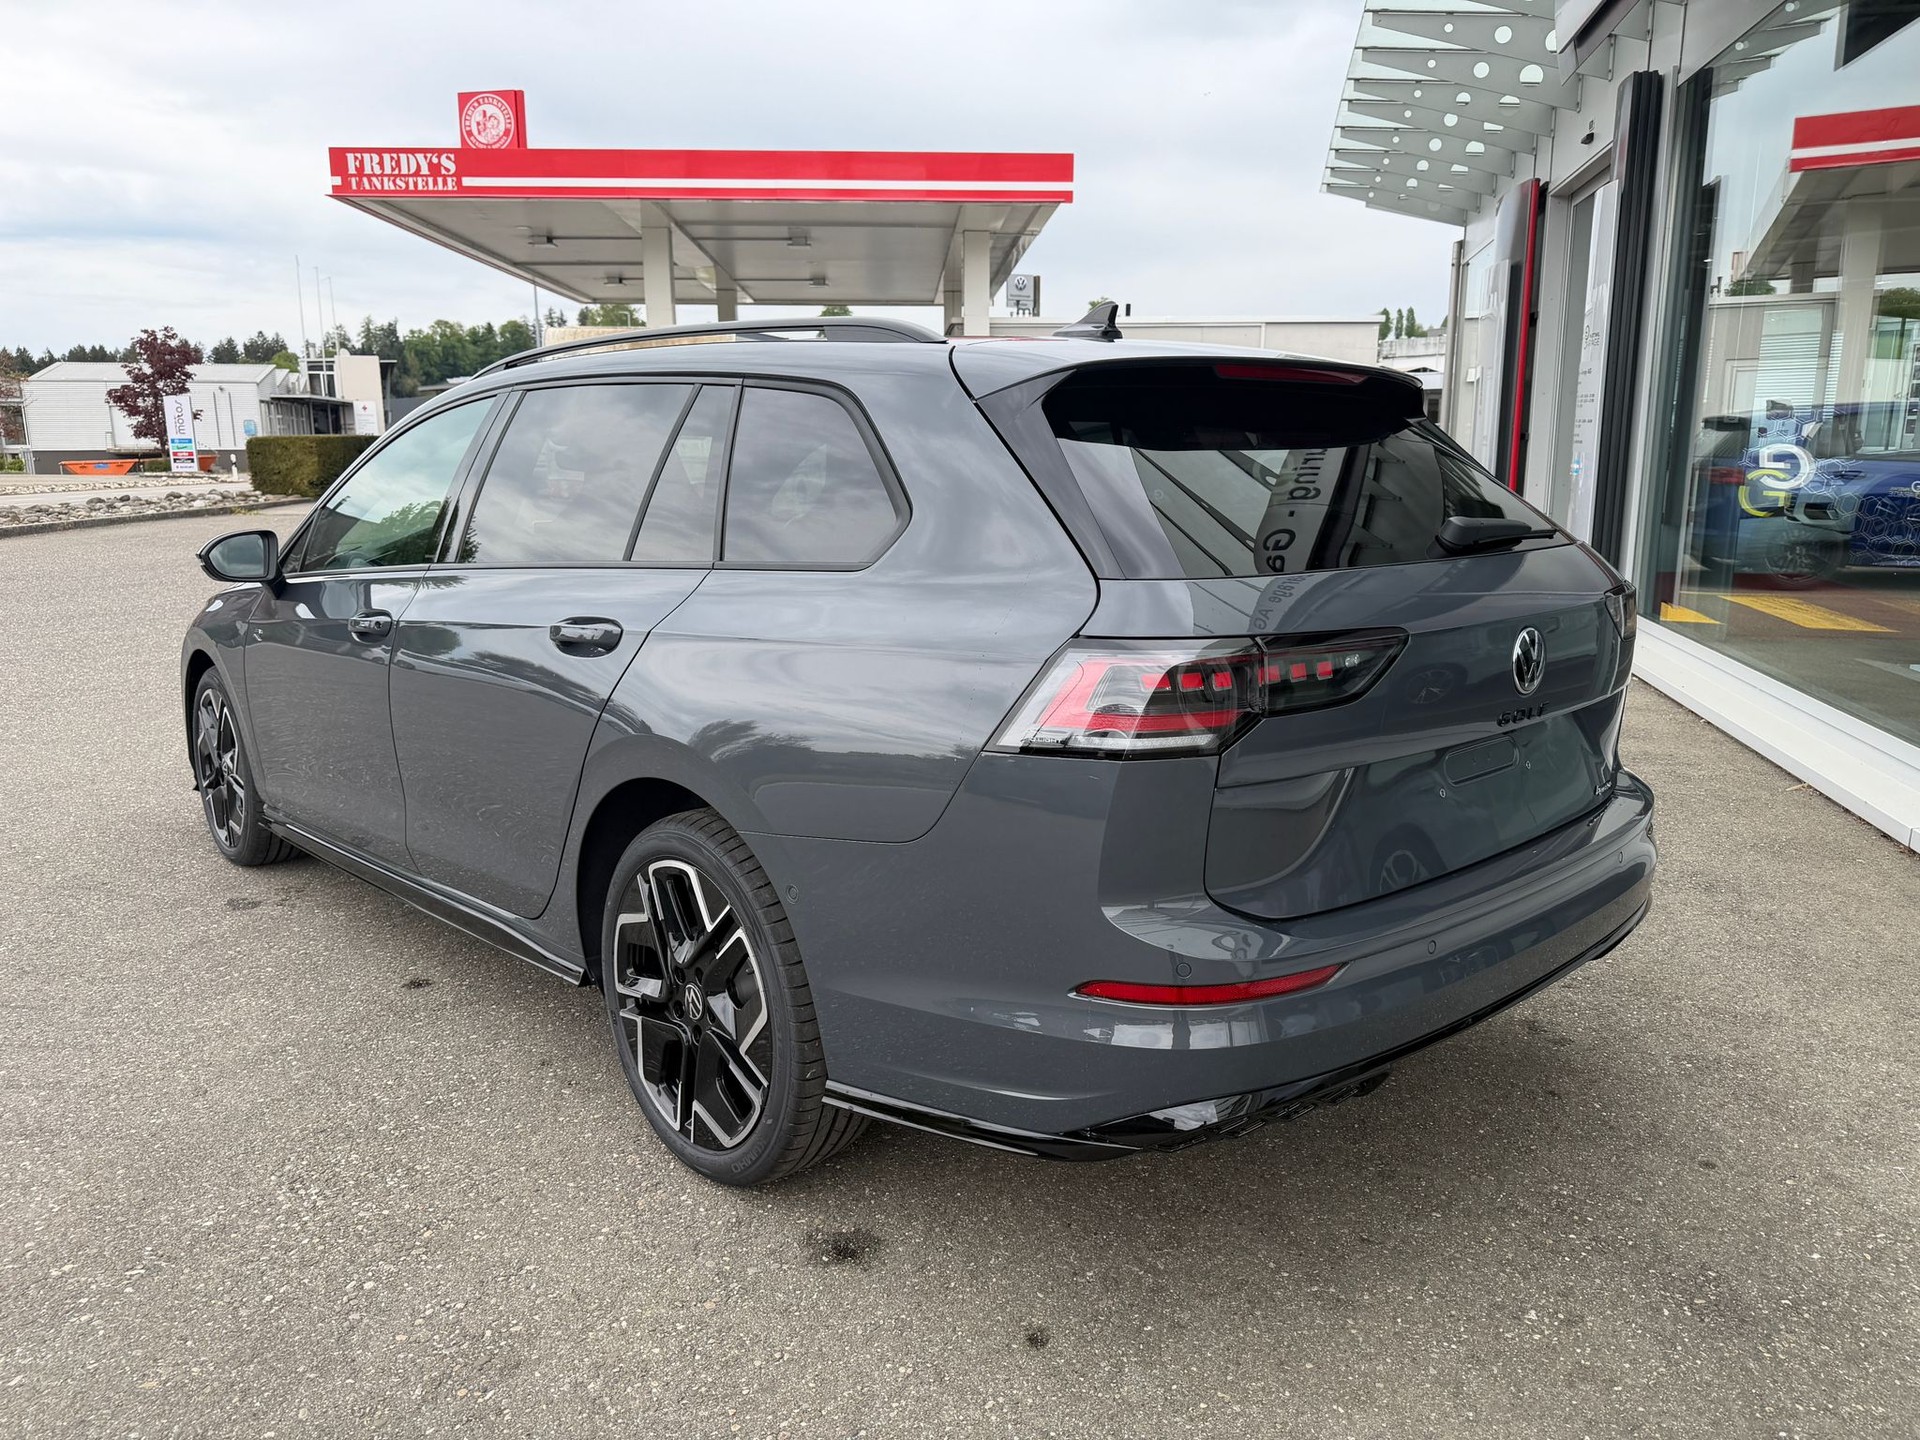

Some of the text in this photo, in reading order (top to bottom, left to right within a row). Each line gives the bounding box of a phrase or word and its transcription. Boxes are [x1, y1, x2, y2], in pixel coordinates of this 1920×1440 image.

[345, 152, 457, 175] FREDY'S
[347, 176, 458, 191] TANKSTELLE
[1497, 700, 1551, 727] GOLF
